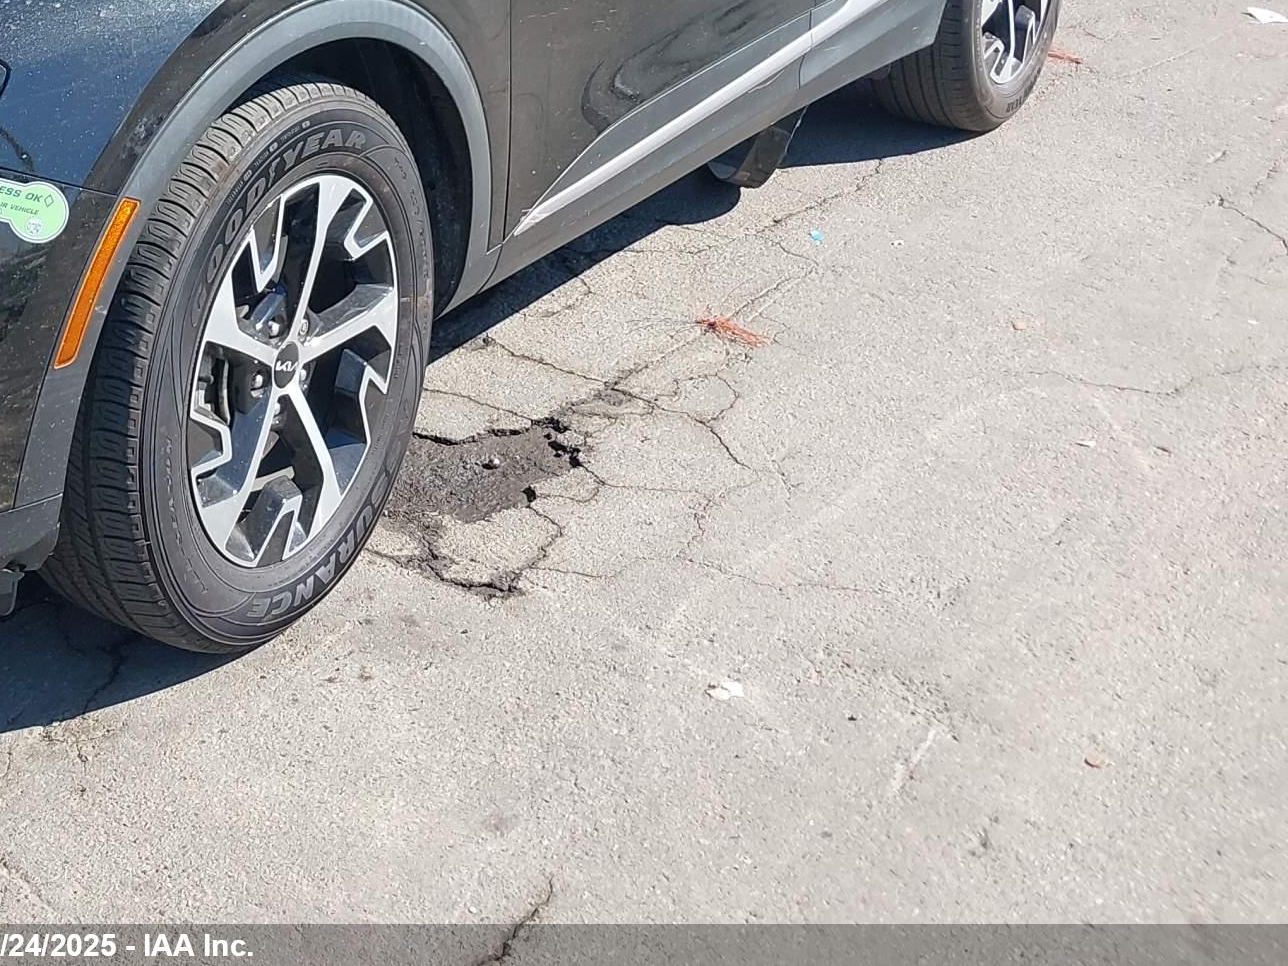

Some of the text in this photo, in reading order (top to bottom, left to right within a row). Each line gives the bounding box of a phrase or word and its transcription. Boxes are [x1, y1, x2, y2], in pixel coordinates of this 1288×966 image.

[25, 192, 43, 203] OK
[10, 203, 40, 216] VEHICLE
[190, 127, 367, 329] GOODYEAR
